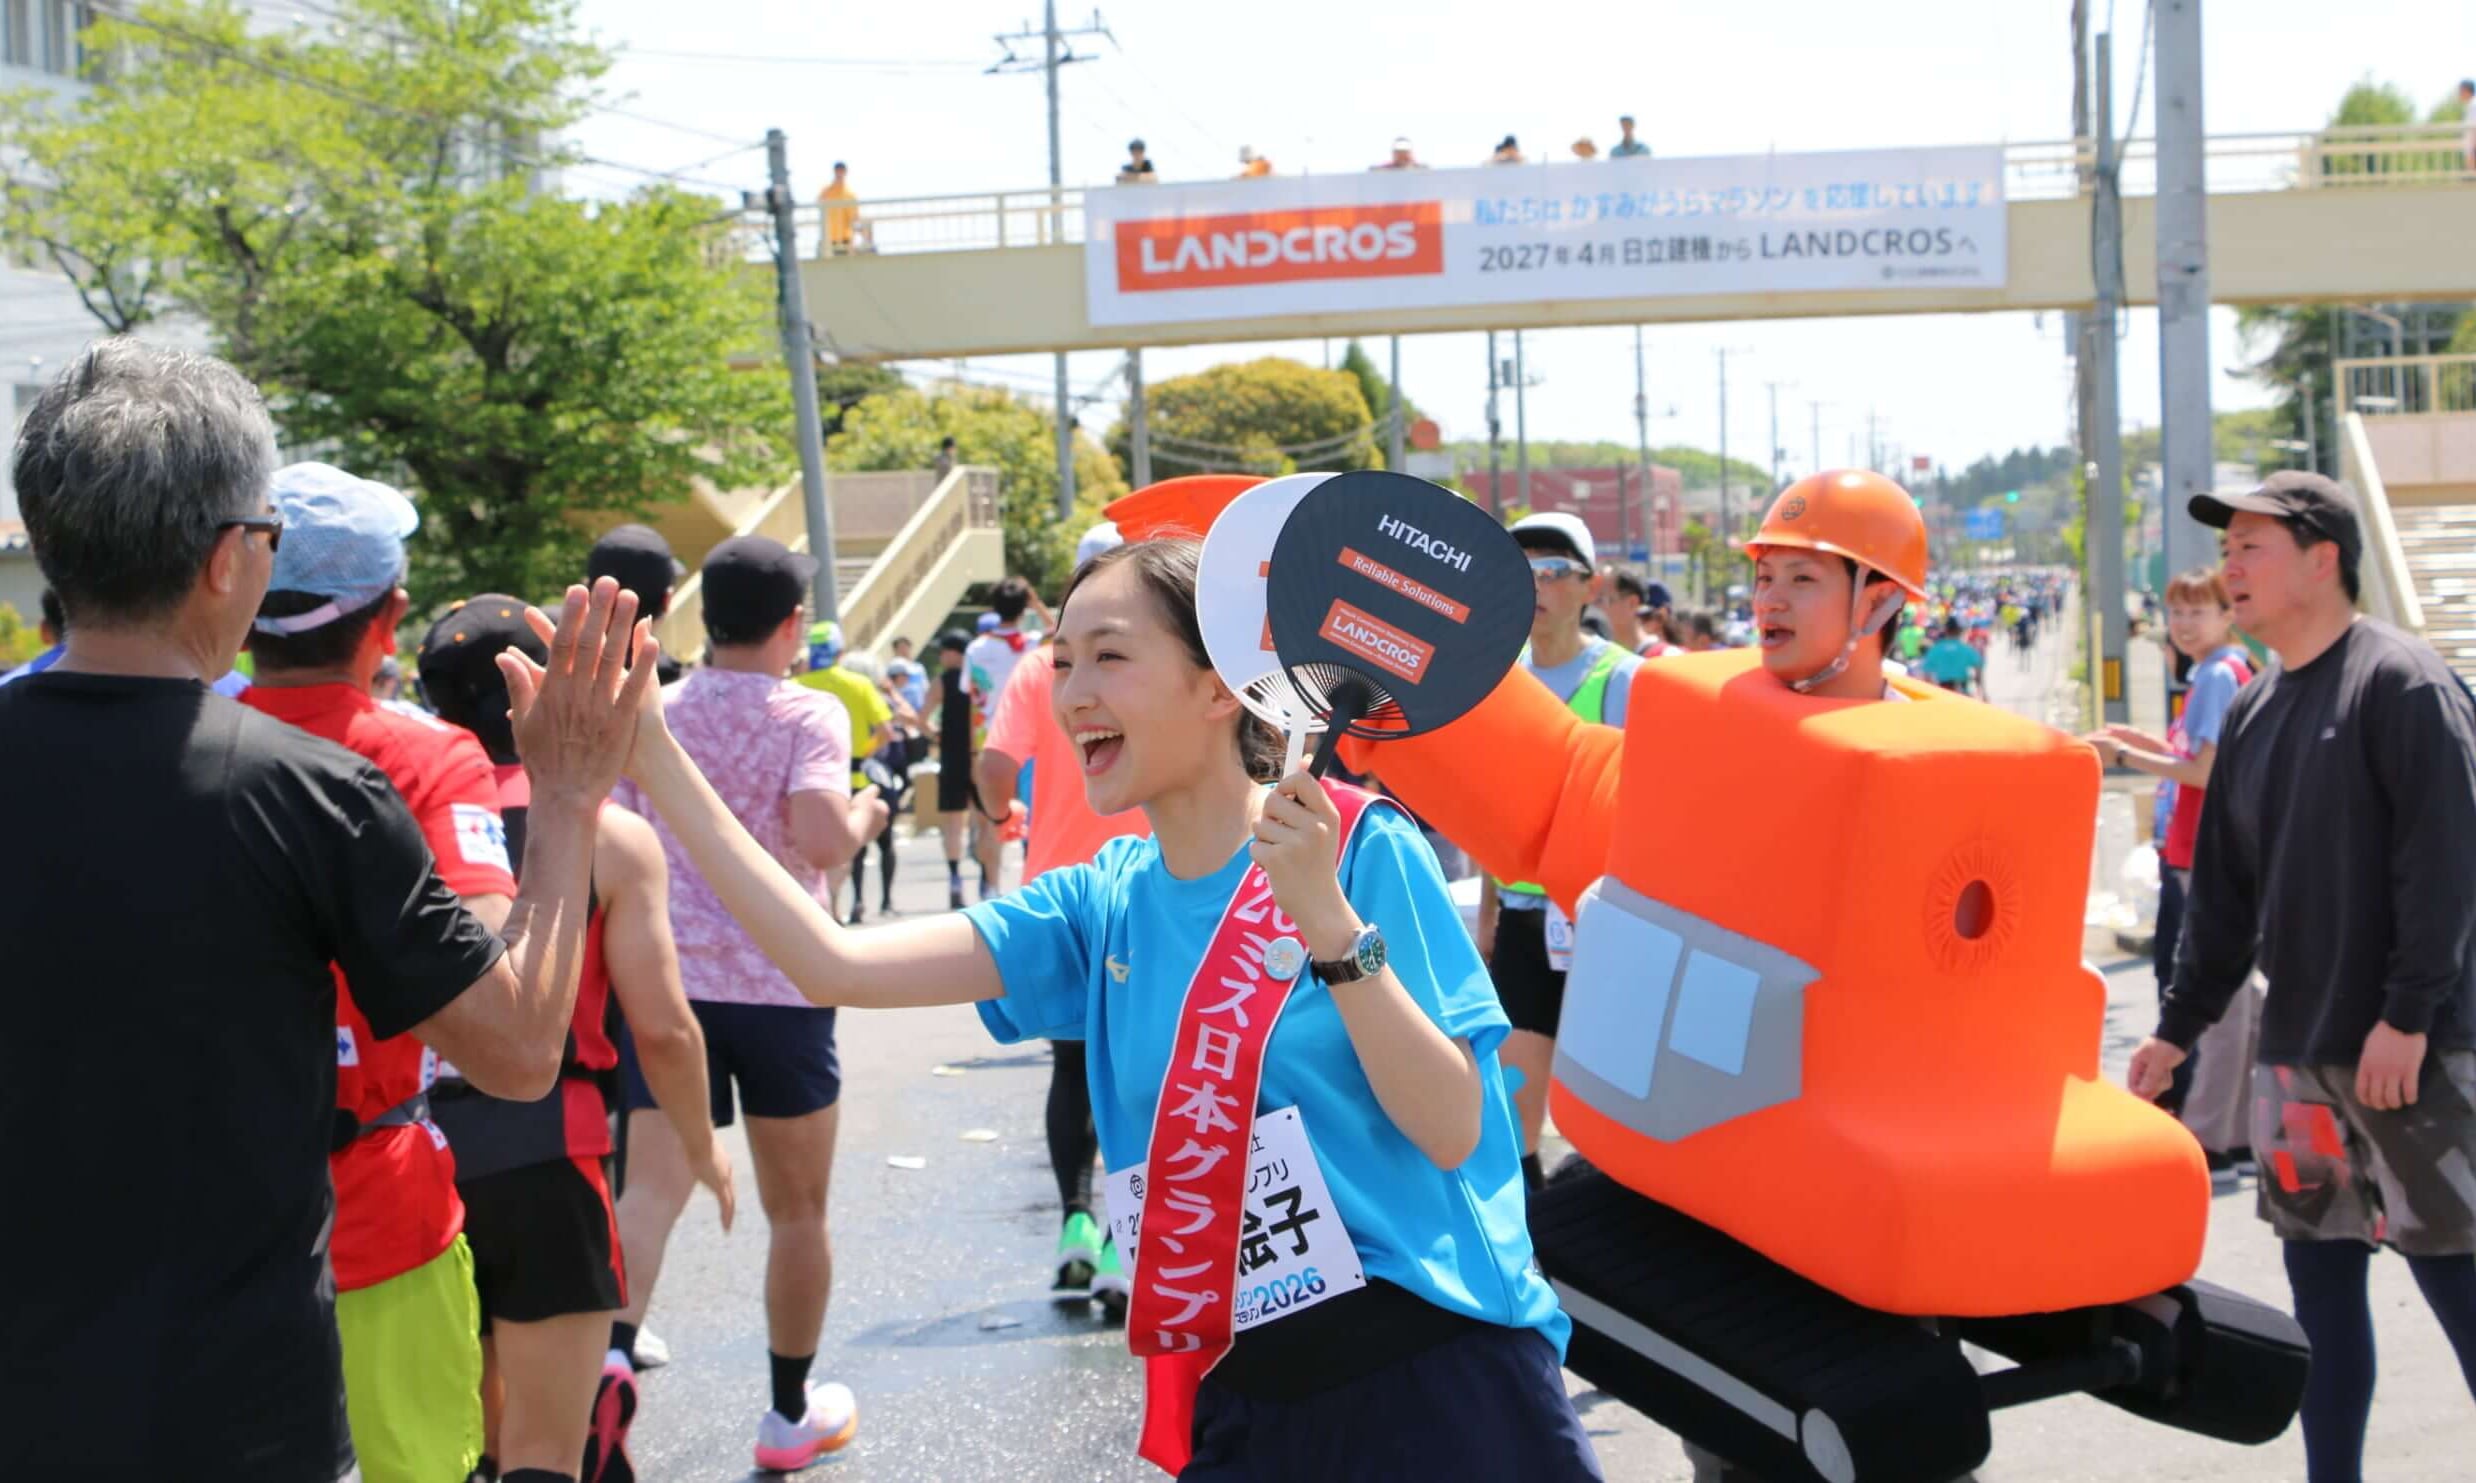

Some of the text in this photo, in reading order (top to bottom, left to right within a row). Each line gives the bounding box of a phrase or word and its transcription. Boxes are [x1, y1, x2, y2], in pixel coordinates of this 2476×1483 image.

[1139, 220, 1417, 275] LANDCROS
[1377, 514, 1472, 572] HITACHI
[1352, 556, 1455, 616] Reliable Solutions
[1331, 615, 1421, 669] LANDCROS
[1254, 1266, 1326, 1316] 2026
